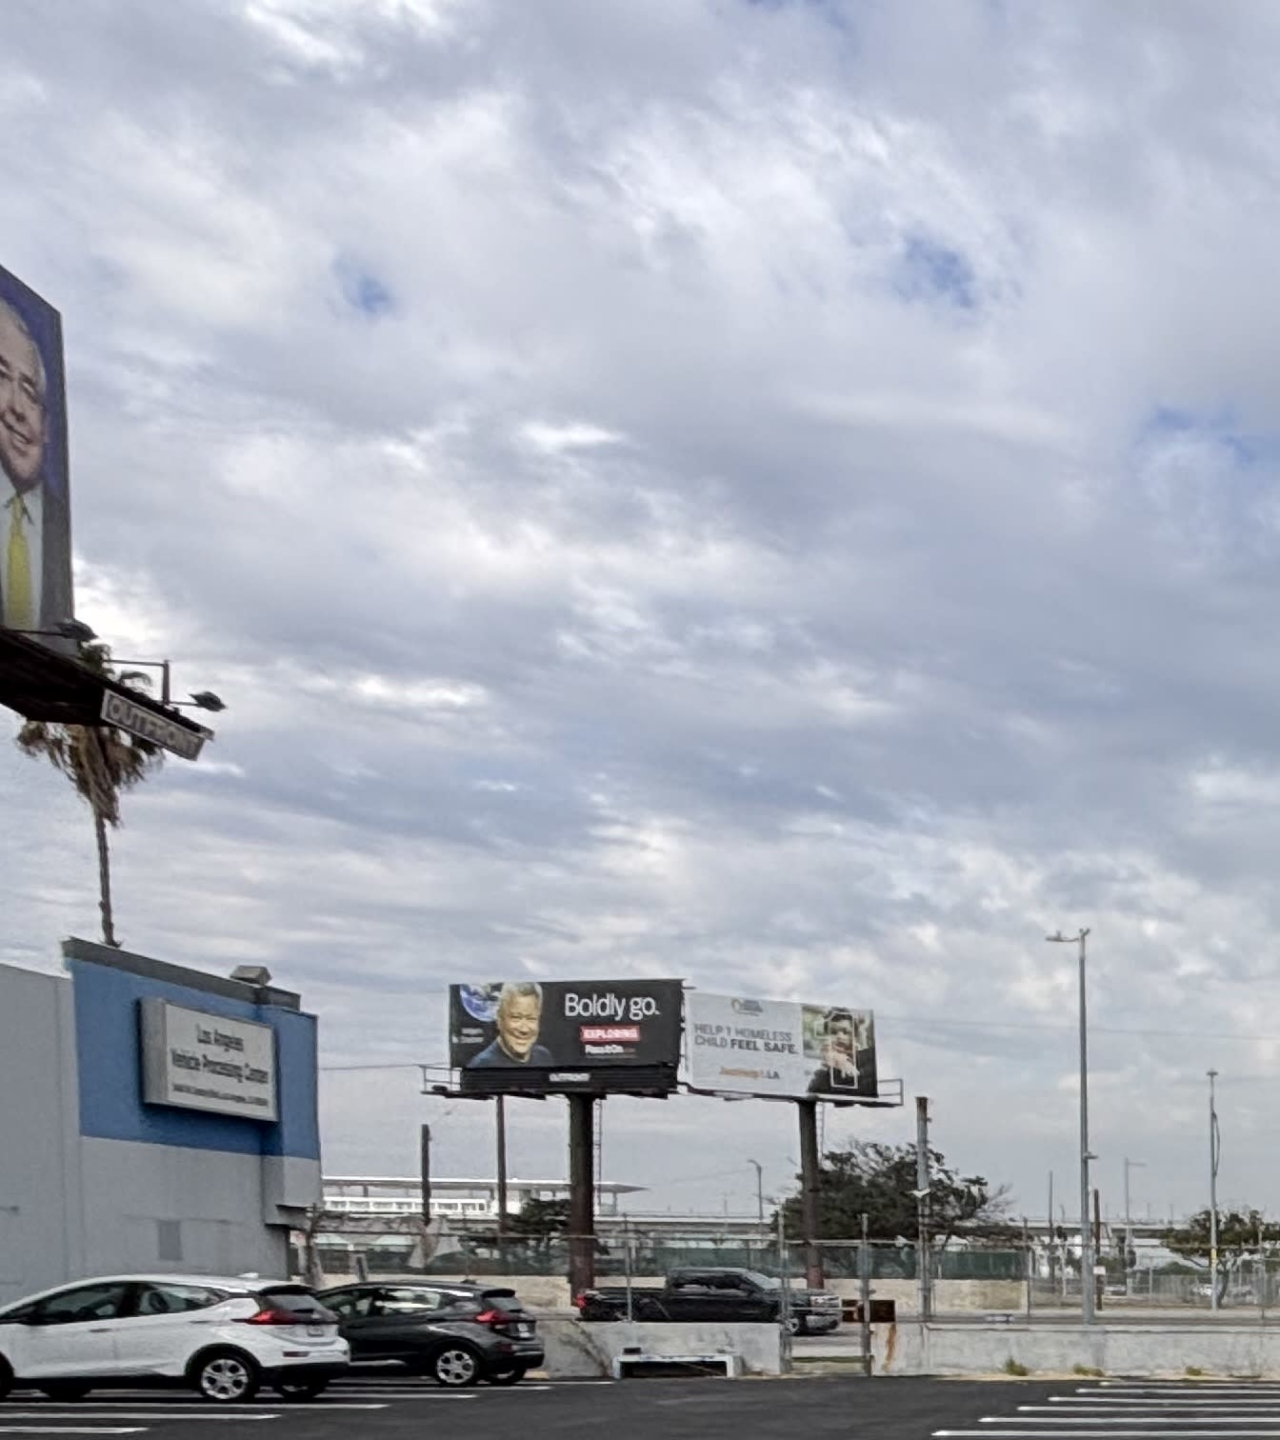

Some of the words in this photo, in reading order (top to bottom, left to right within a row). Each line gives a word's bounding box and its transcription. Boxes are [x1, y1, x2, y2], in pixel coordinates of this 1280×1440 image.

[564, 992, 627, 1021] Boldly
[628, 996, 661, 1021] go.
[694, 1023, 724, 1036] HELP
[734, 1027, 792, 1042] HOMELESS
[694, 1034, 727, 1049] CHILD
[730, 1038, 761, 1052] FEEL
